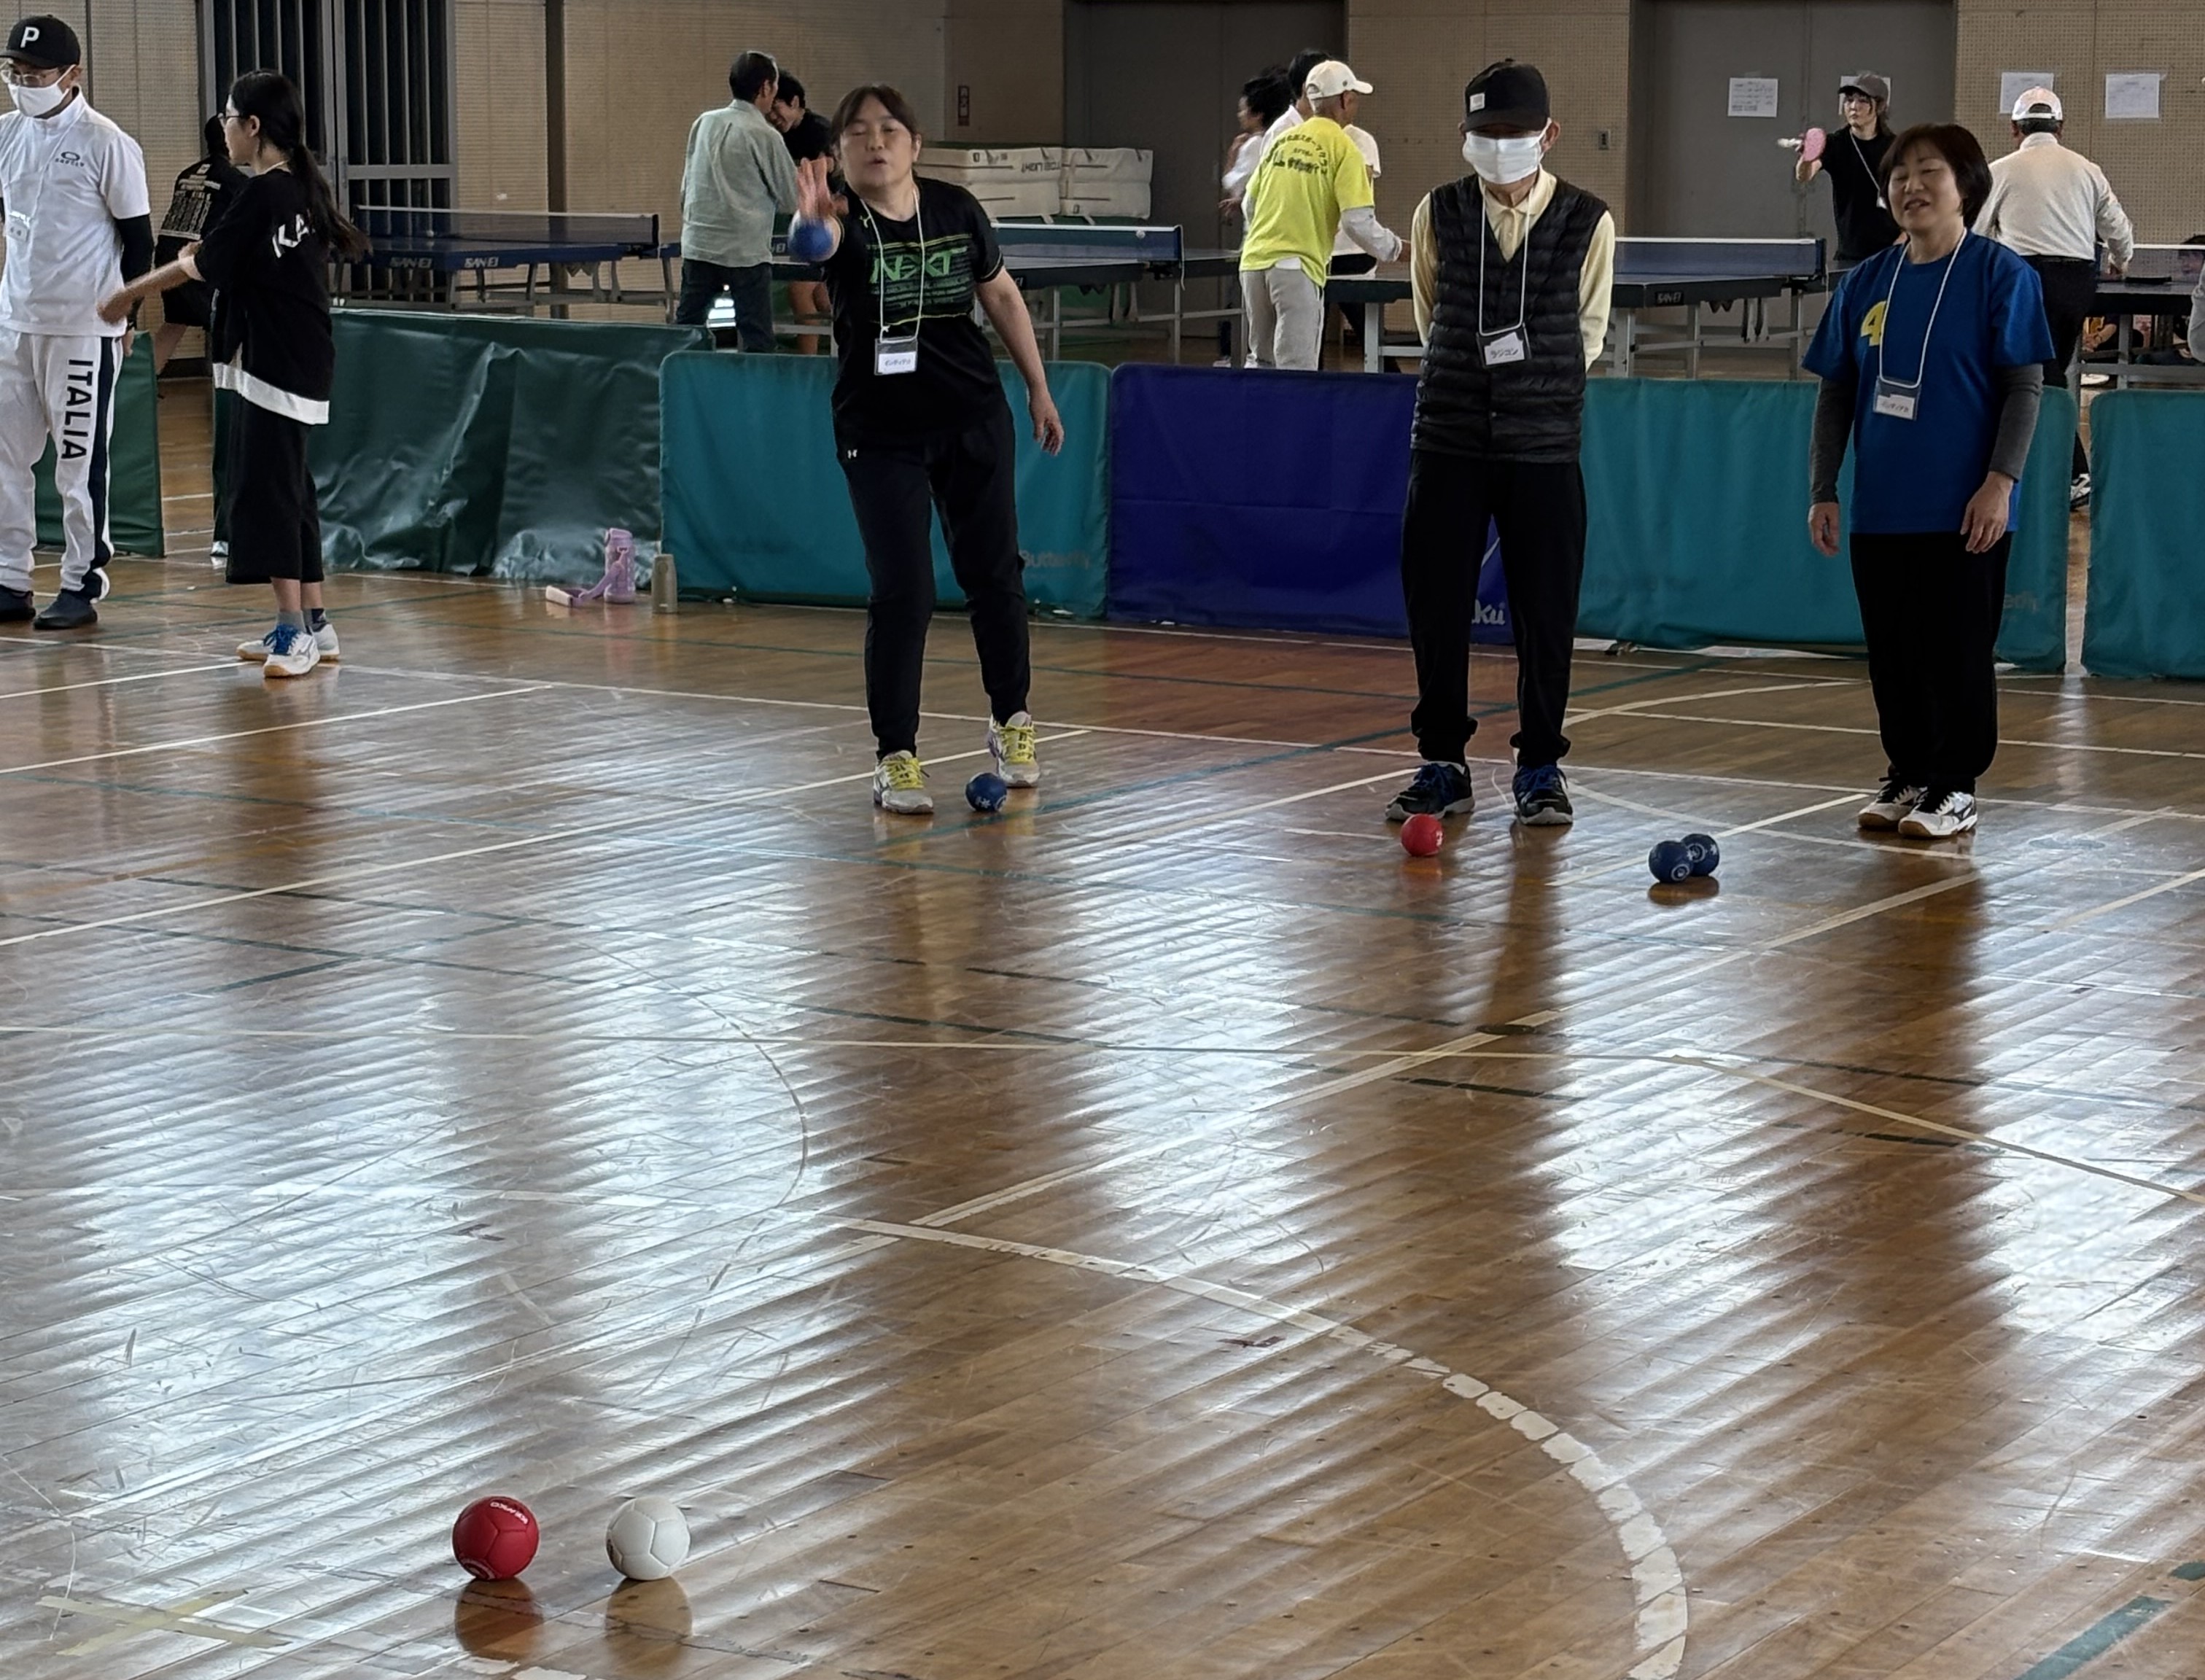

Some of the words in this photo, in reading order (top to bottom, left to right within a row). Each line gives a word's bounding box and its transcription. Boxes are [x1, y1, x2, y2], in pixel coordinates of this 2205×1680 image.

[20, 26, 39, 48] P
[464, 257, 499, 268] SANEI
[61, 359, 93, 459] ITALIA
